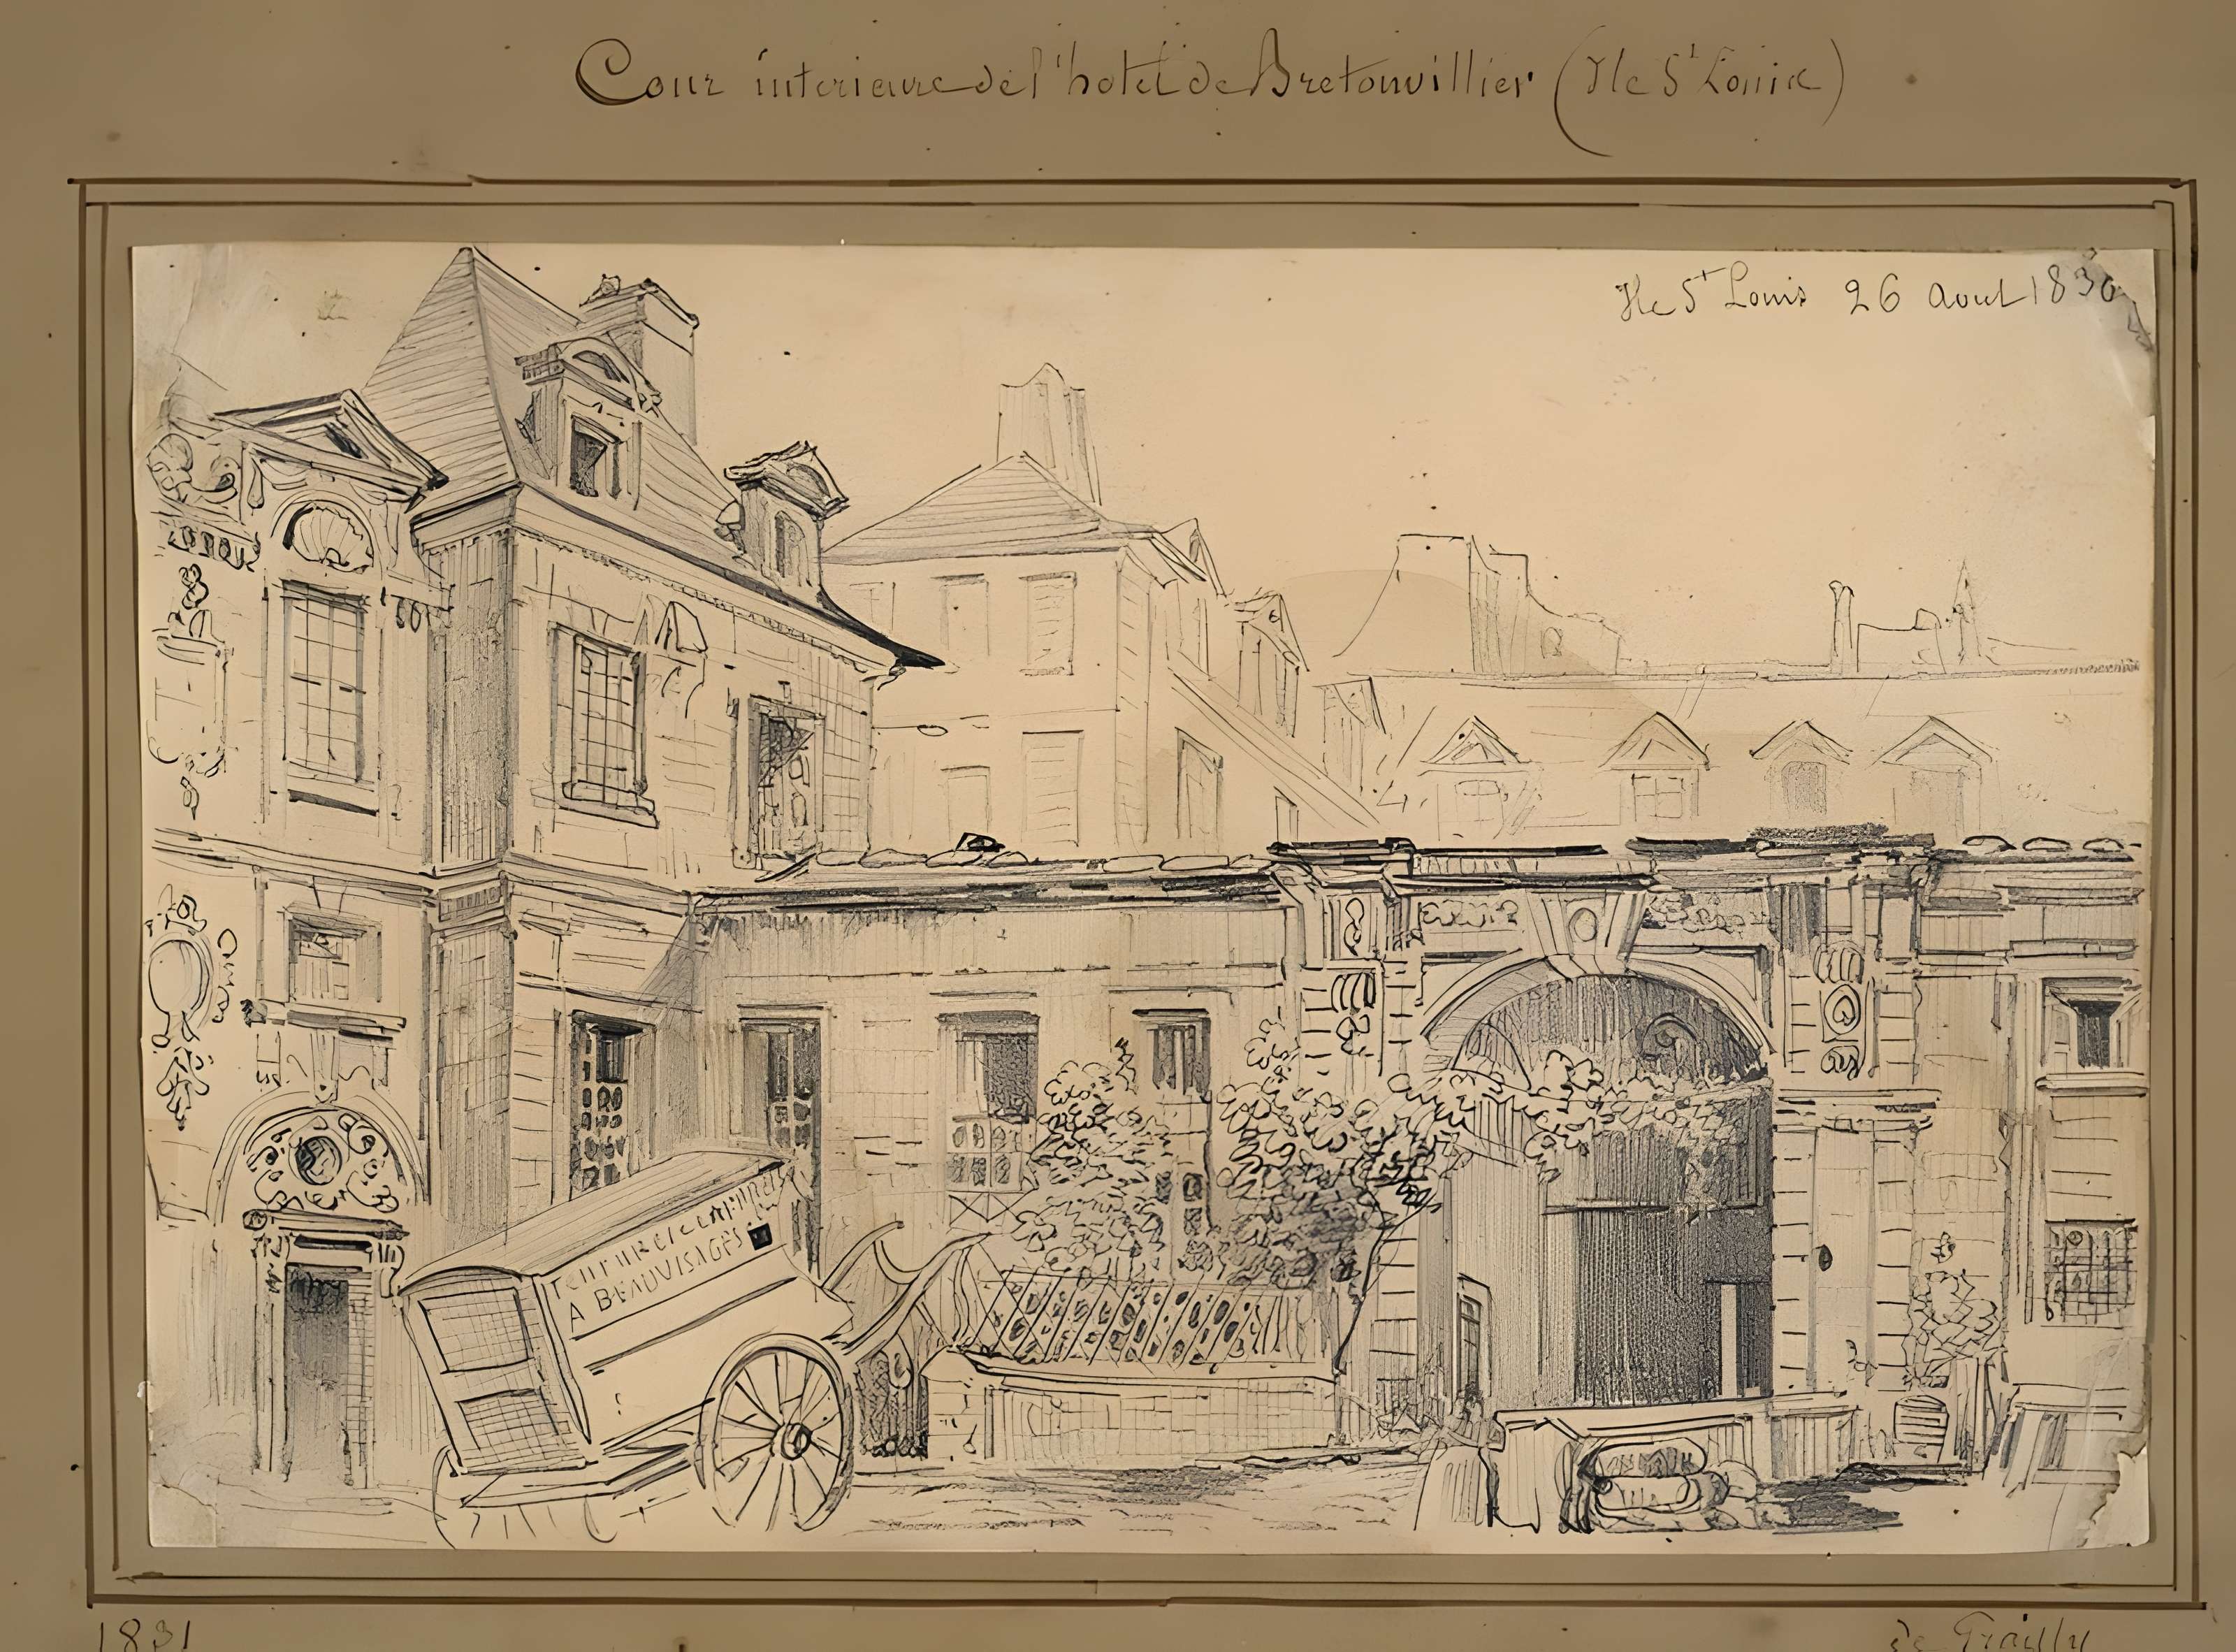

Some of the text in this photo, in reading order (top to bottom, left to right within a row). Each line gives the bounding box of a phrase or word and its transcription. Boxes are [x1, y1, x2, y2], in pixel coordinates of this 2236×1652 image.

[575, 38, 725, 106] Cour
[1189, 60, 1251, 95] de
[1725, 260, 1807, 308] Louis
[1845, 275, 1901, 314] 26
